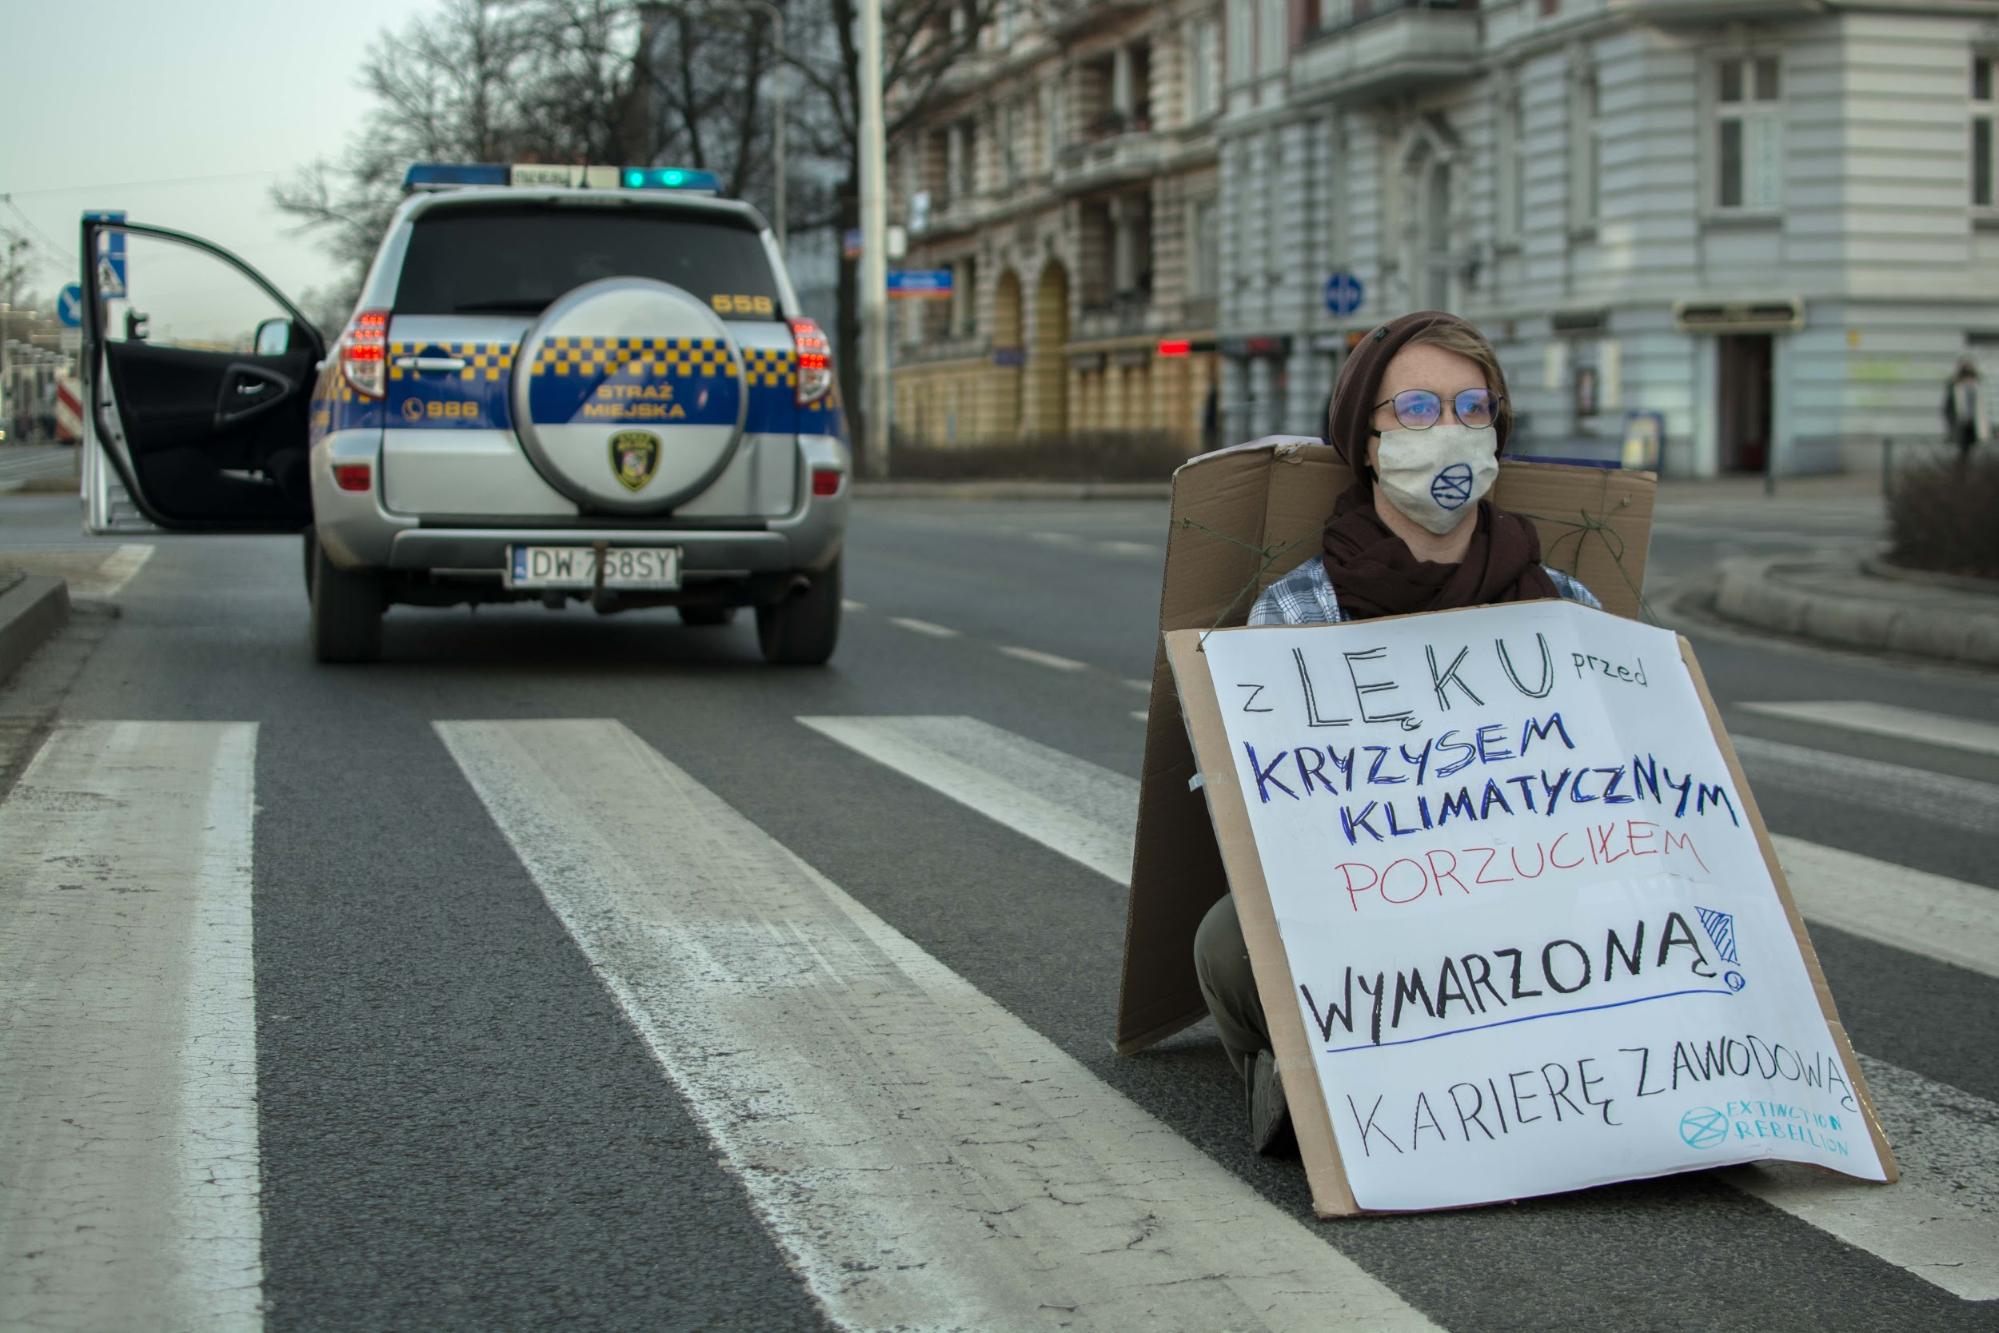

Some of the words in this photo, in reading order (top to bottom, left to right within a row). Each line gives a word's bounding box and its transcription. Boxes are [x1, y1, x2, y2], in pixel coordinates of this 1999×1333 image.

[597, 381, 673, 400] STRAŻ
[427, 400, 479, 418] 986
[583, 403, 686, 418] MIEJSKA
[532, 550, 573, 578] DW
[1291, 632, 1554, 731] LĘKU
[1571, 652, 1648, 688] przed
[1243, 711, 1576, 804] KRYZYSEM
[1339, 752, 1741, 846] KLIMATYCZNYM
[1334, 819, 1711, 912] PORZUCIŁEM
[1346, 1057, 1623, 1157] KARIERĘ
[1617, 1034, 1858, 1113] ZAWODOWĄ
[1726, 1100, 1843, 1132] EXTINCTION
[1735, 1120, 1849, 1156] REBELLION
